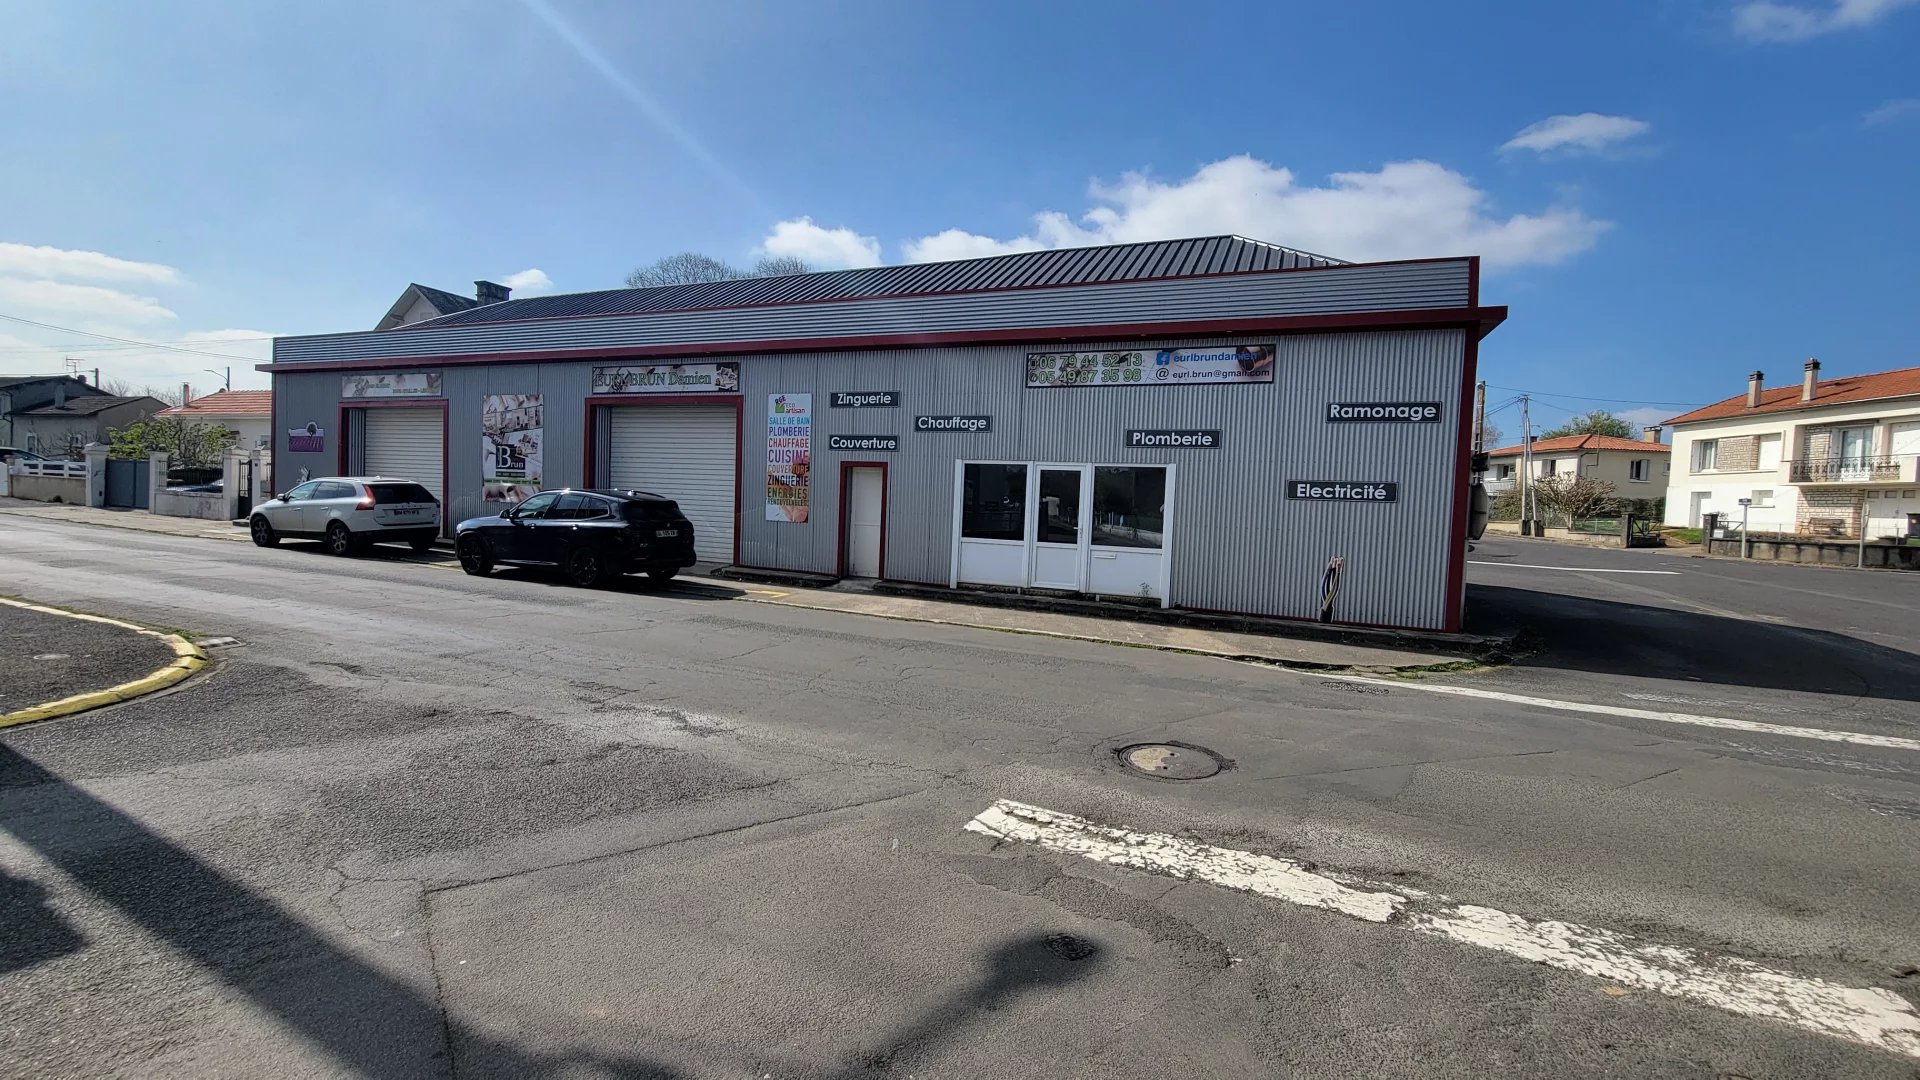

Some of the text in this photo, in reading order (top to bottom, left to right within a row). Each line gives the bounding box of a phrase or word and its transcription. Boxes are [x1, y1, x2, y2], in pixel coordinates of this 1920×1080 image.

[1039, 352, 1143, 369] 06 79 44 52 13
[629, 371, 667, 387] BRUN
[668, 370, 712, 386] Damien
[1038, 368, 1142, 384] 05 49 87 35 98
[1172, 369, 1270, 379] eurl.brun@gmail.com
[837, 392, 892, 407] Zinguerie
[1330, 404, 1437, 421] Ramonage
[769, 416, 810, 425] SALLE DE BAIN
[918, 416, 987, 431] Chauffage
[769, 426, 810, 436] PLOMBERIE
[768, 438, 809, 448] CHAUFFAGE
[830, 437, 896, 449] Couverture
[1132, 432, 1213, 446] Plomberie
[497, 446, 524, 469] Brun
[768, 449, 809, 464] CUISINE
[767, 475, 809, 487] ZINGUERIE
[767, 487, 808, 499] ENERGIES
[1296, 483, 1387, 500] Electricité
